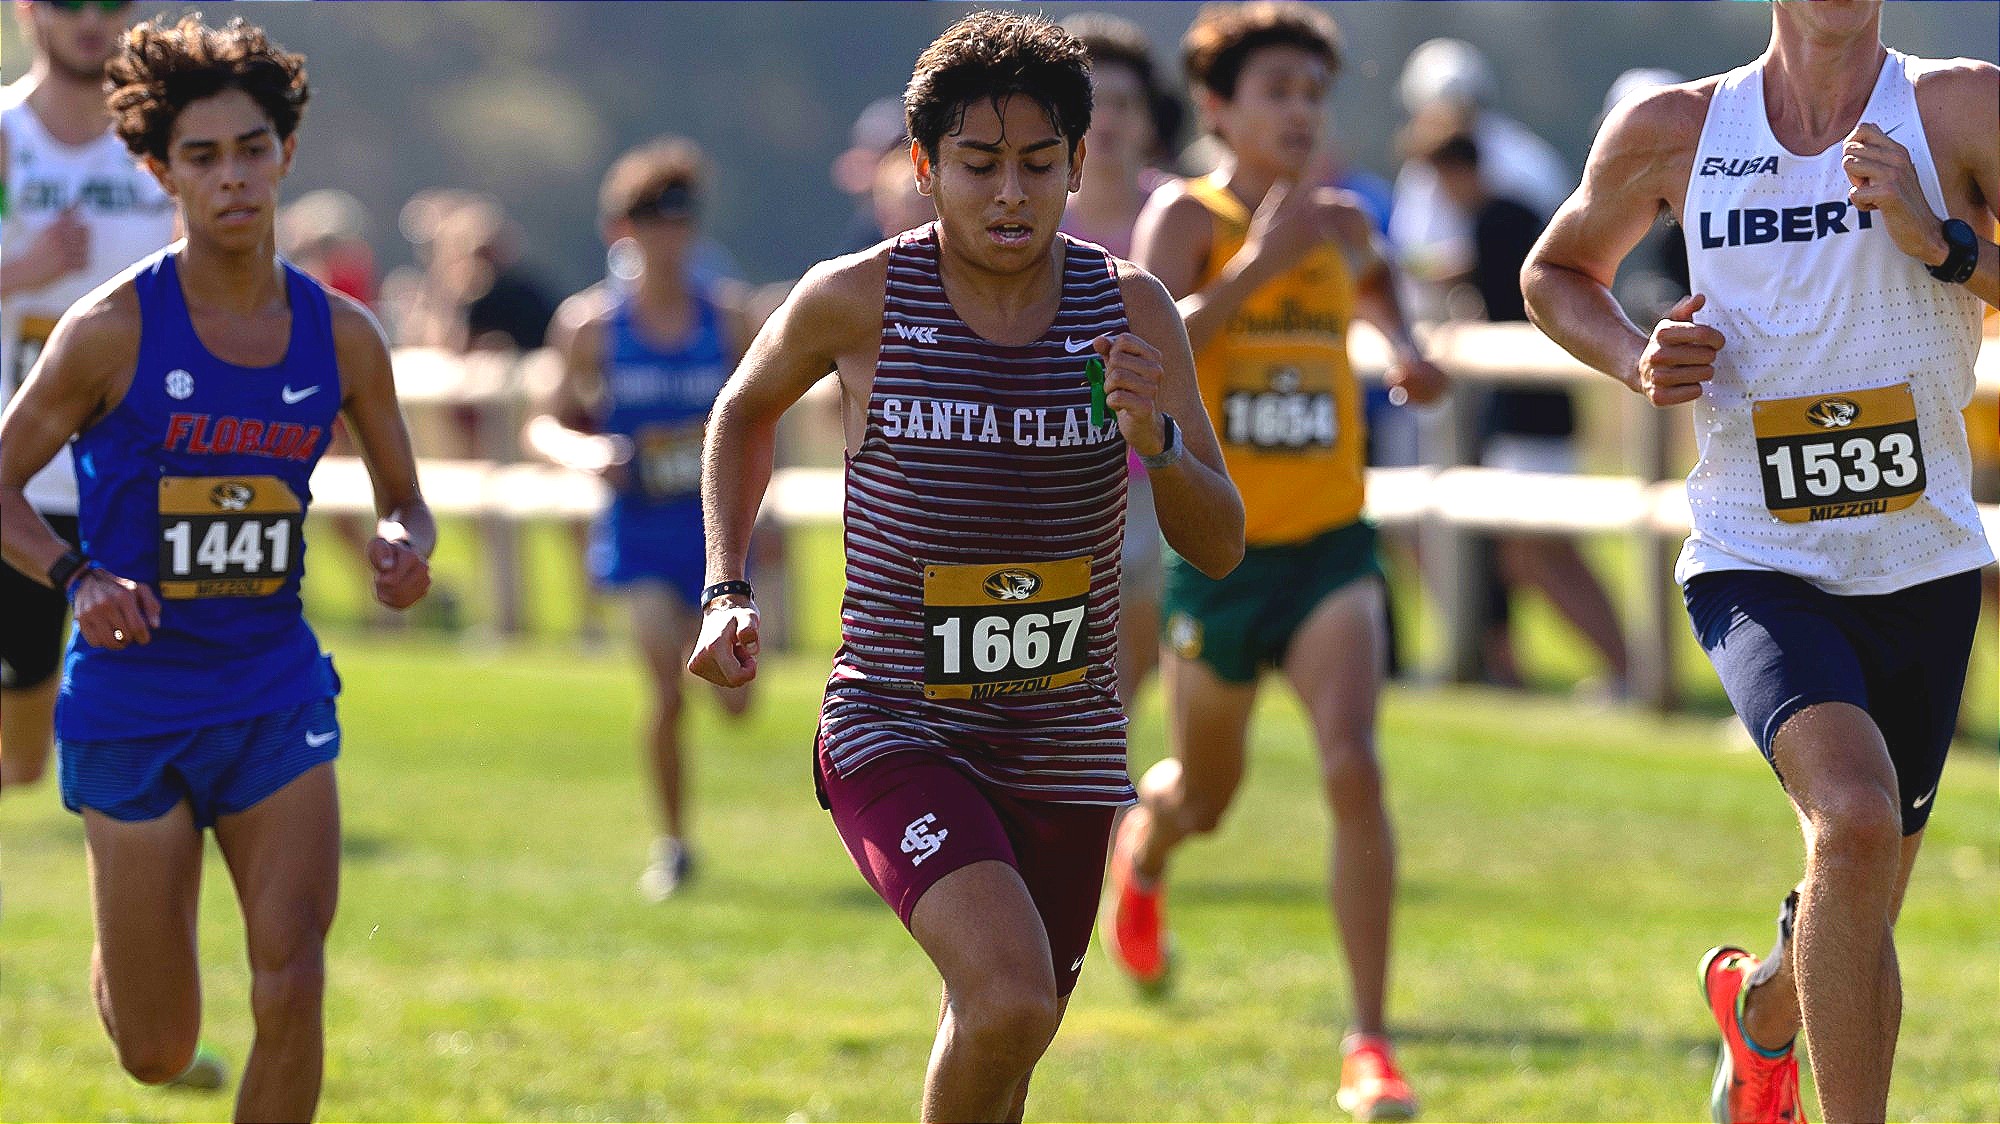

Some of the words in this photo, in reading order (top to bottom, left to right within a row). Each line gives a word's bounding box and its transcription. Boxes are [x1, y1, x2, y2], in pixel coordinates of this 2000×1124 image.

[1701, 199, 1874, 250] LIBERT
[163, 412, 323, 463] FLORIDA
[882, 399, 1001, 443] SANTA
[1226, 392, 1337, 446] 1654
[1766, 432, 1919, 500] 1533
[1809, 500, 1888, 522] MIZZOU
[164, 518, 291, 576] 1441
[932, 604, 1086, 674] 1667
[970, 676, 1053, 701] MIZZOU
